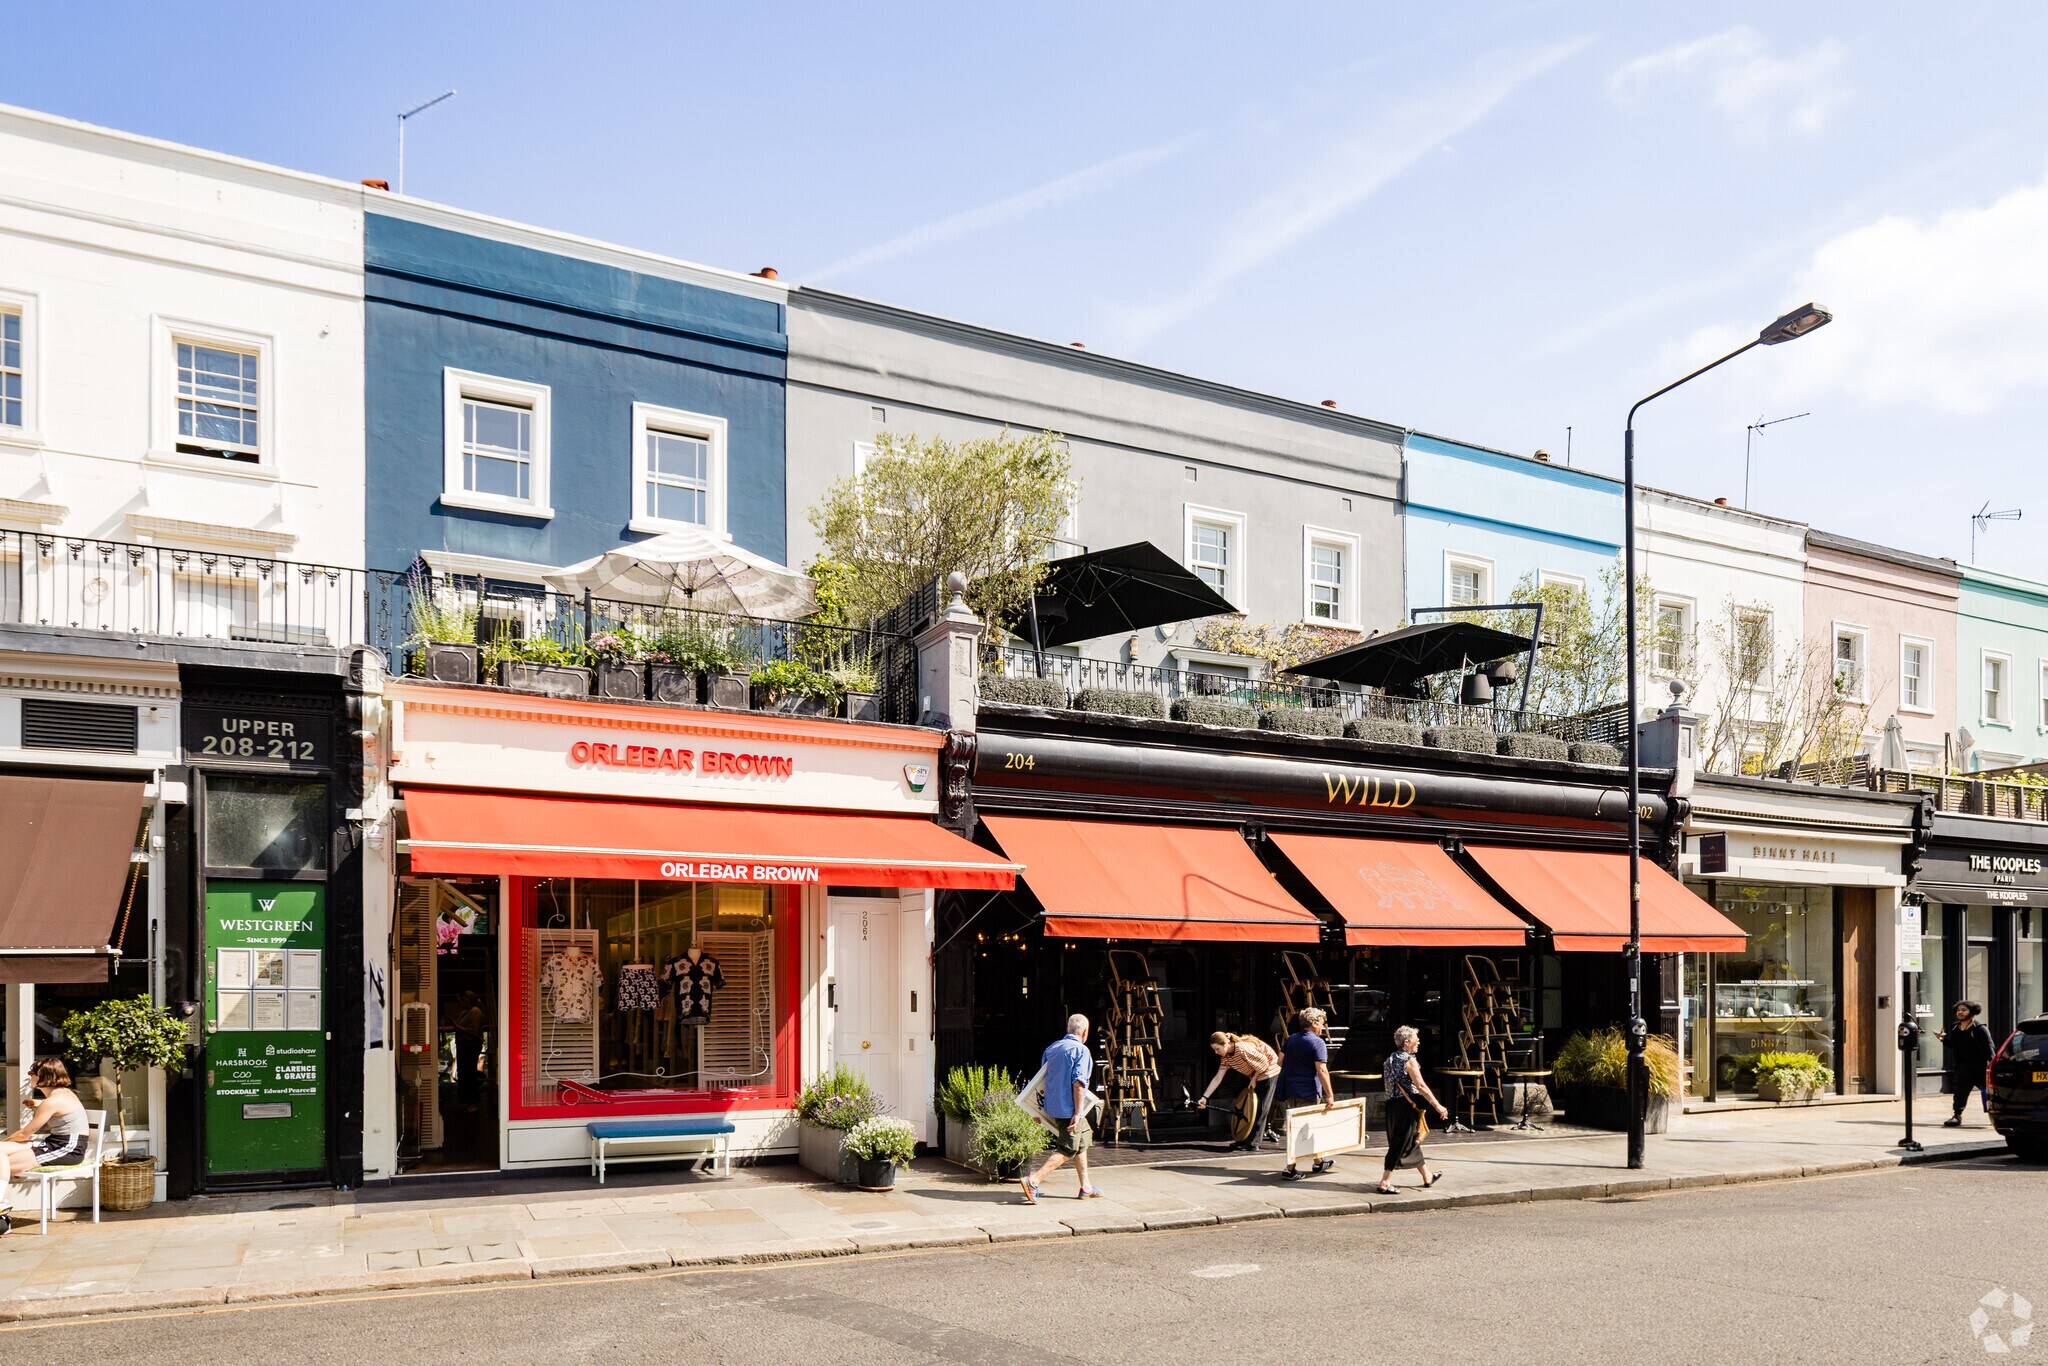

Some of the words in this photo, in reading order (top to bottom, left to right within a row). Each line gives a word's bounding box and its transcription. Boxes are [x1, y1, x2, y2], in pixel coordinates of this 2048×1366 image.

[222, 718, 294, 737] UPPER
[202, 736, 314, 760] 208-212
[571, 741, 694, 770] ORLEBAR
[702, 751, 793, 776] BROWN
[1004, 752, 1035, 770] 204
[1322, 772, 1416, 808] WILD
[1753, 845, 1797, 859] DINNY
[1802, 850, 1838, 863] HALL
[1970, 854, 1991, 869] THE
[1993, 856, 2042, 873] KOOPLES
[660, 861, 748, 880] ORLEBAR
[753, 864, 819, 882] BROWN
[1996, 874, 2016, 883] PARIS
[1985, 890, 1999, 899] THE
[1999, 892, 2028, 901] KOOPLES
[219, 918, 313, 932] WESTGREEN
[246, 936, 269, 944] SINCE
[1915, 1004, 1931, 1012] SALE
[1750, 1038, 1780, 1048] DINNY
[276, 1047, 316, 1055] studioshaw
[216, 1059, 268, 1067] HARSBROOK
[275, 1065, 317, 1073] CLARENCE
[284, 1072, 317, 1080] GRAVES
[2036, 1072, 2048, 1081] HX
